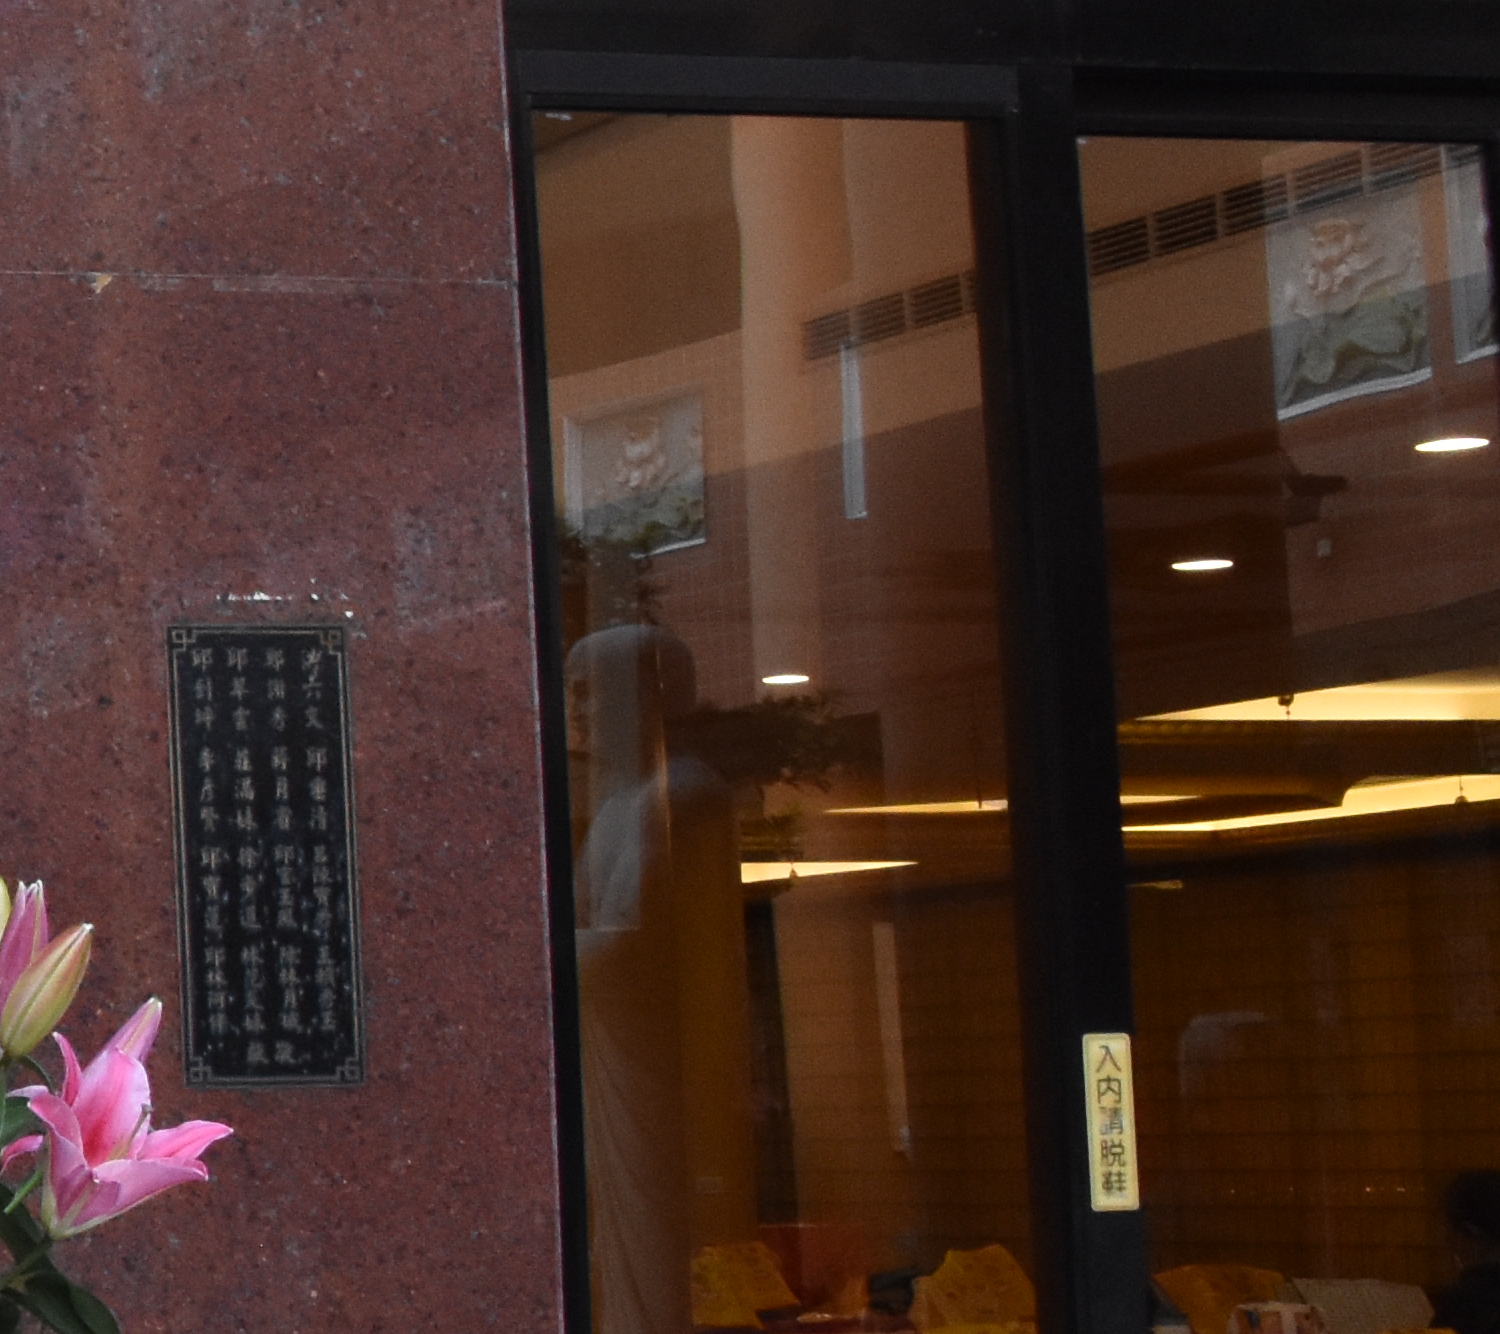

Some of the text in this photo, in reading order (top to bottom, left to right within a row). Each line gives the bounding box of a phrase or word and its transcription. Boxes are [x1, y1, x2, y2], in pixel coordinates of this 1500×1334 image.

[1096, 1045, 1127, 1197] 入內請脫鞋
